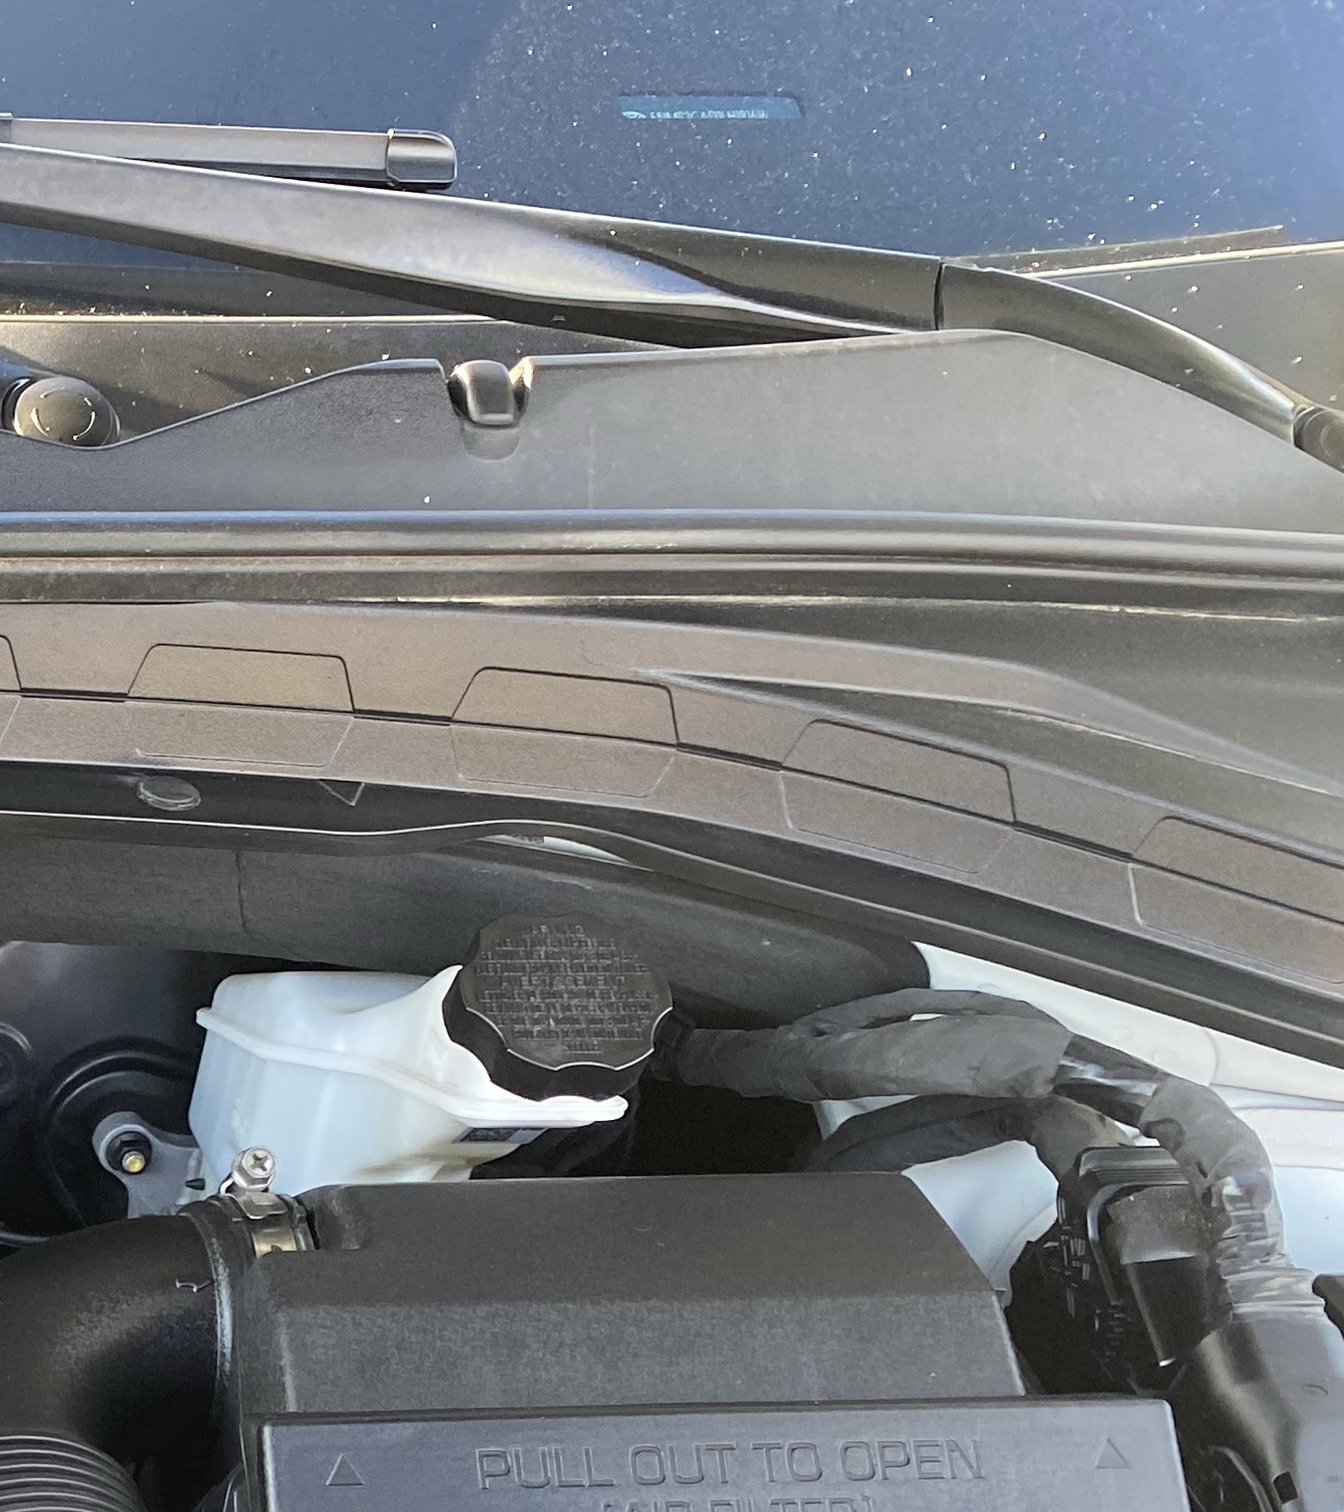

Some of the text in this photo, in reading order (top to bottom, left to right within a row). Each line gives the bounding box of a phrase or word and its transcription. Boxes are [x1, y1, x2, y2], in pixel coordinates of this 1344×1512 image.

[475, 1438, 986, 1490] PULL OUT TO OPEN
